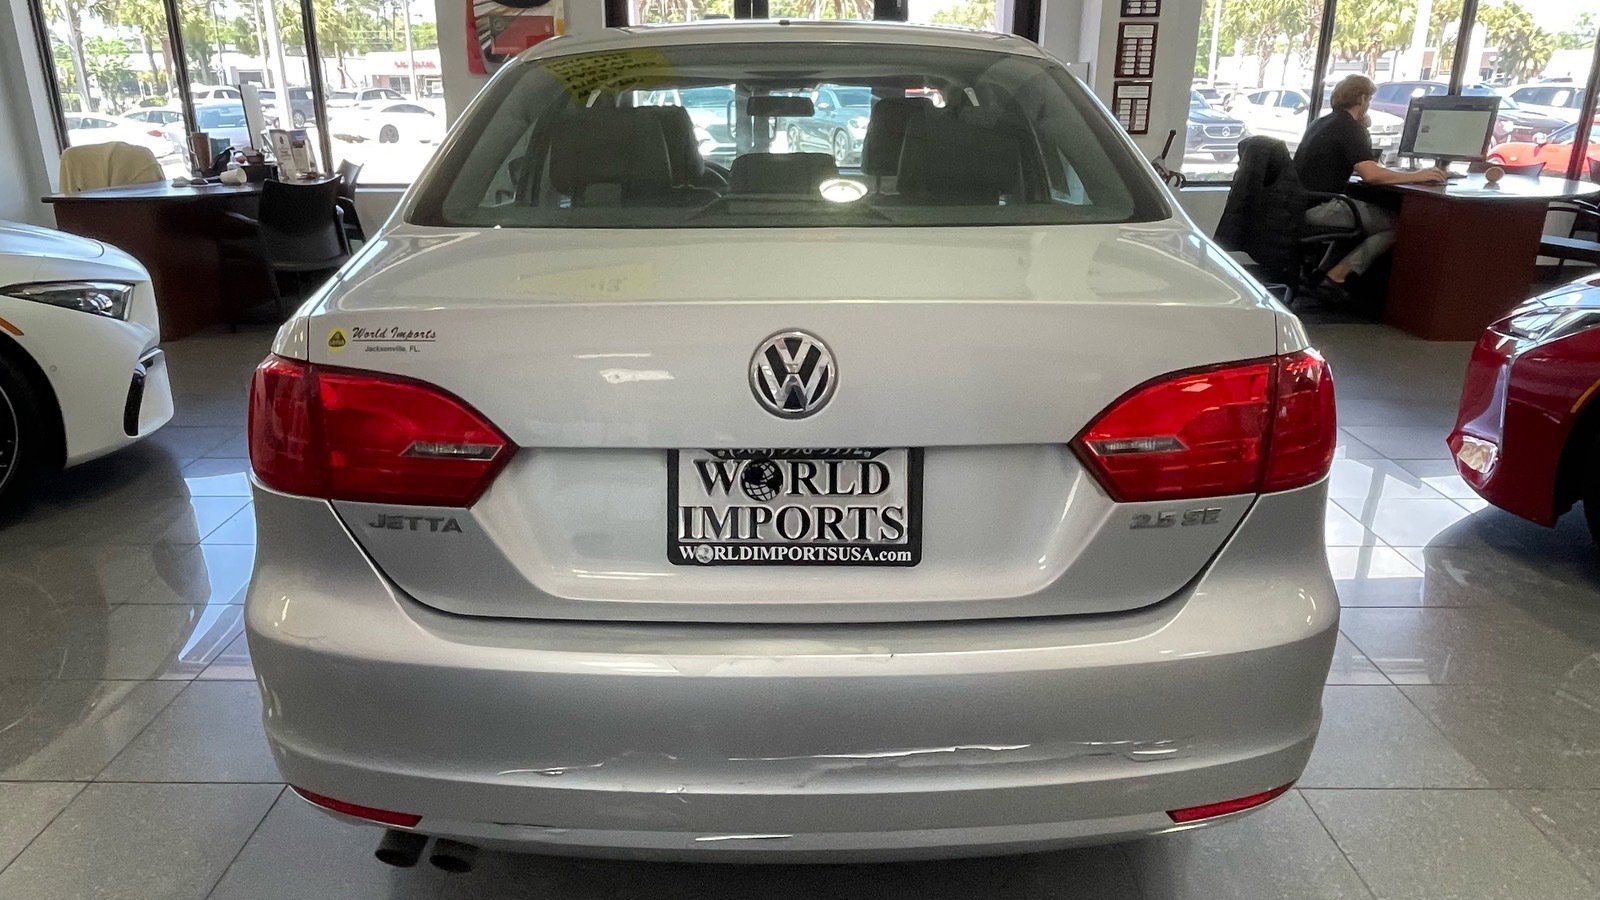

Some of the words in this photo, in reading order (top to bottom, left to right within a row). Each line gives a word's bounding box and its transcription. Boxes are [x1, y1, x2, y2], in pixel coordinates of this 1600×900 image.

[352, 327, 388, 338] World
[390, 326, 436, 341] Imports
[755, 332, 832, 413] VW
[693, 458, 890, 501] WORLD
[368, 514, 463, 533] JETTA
[680, 506, 905, 541] IMPORTS
[1180, 507, 1222, 527] SE
